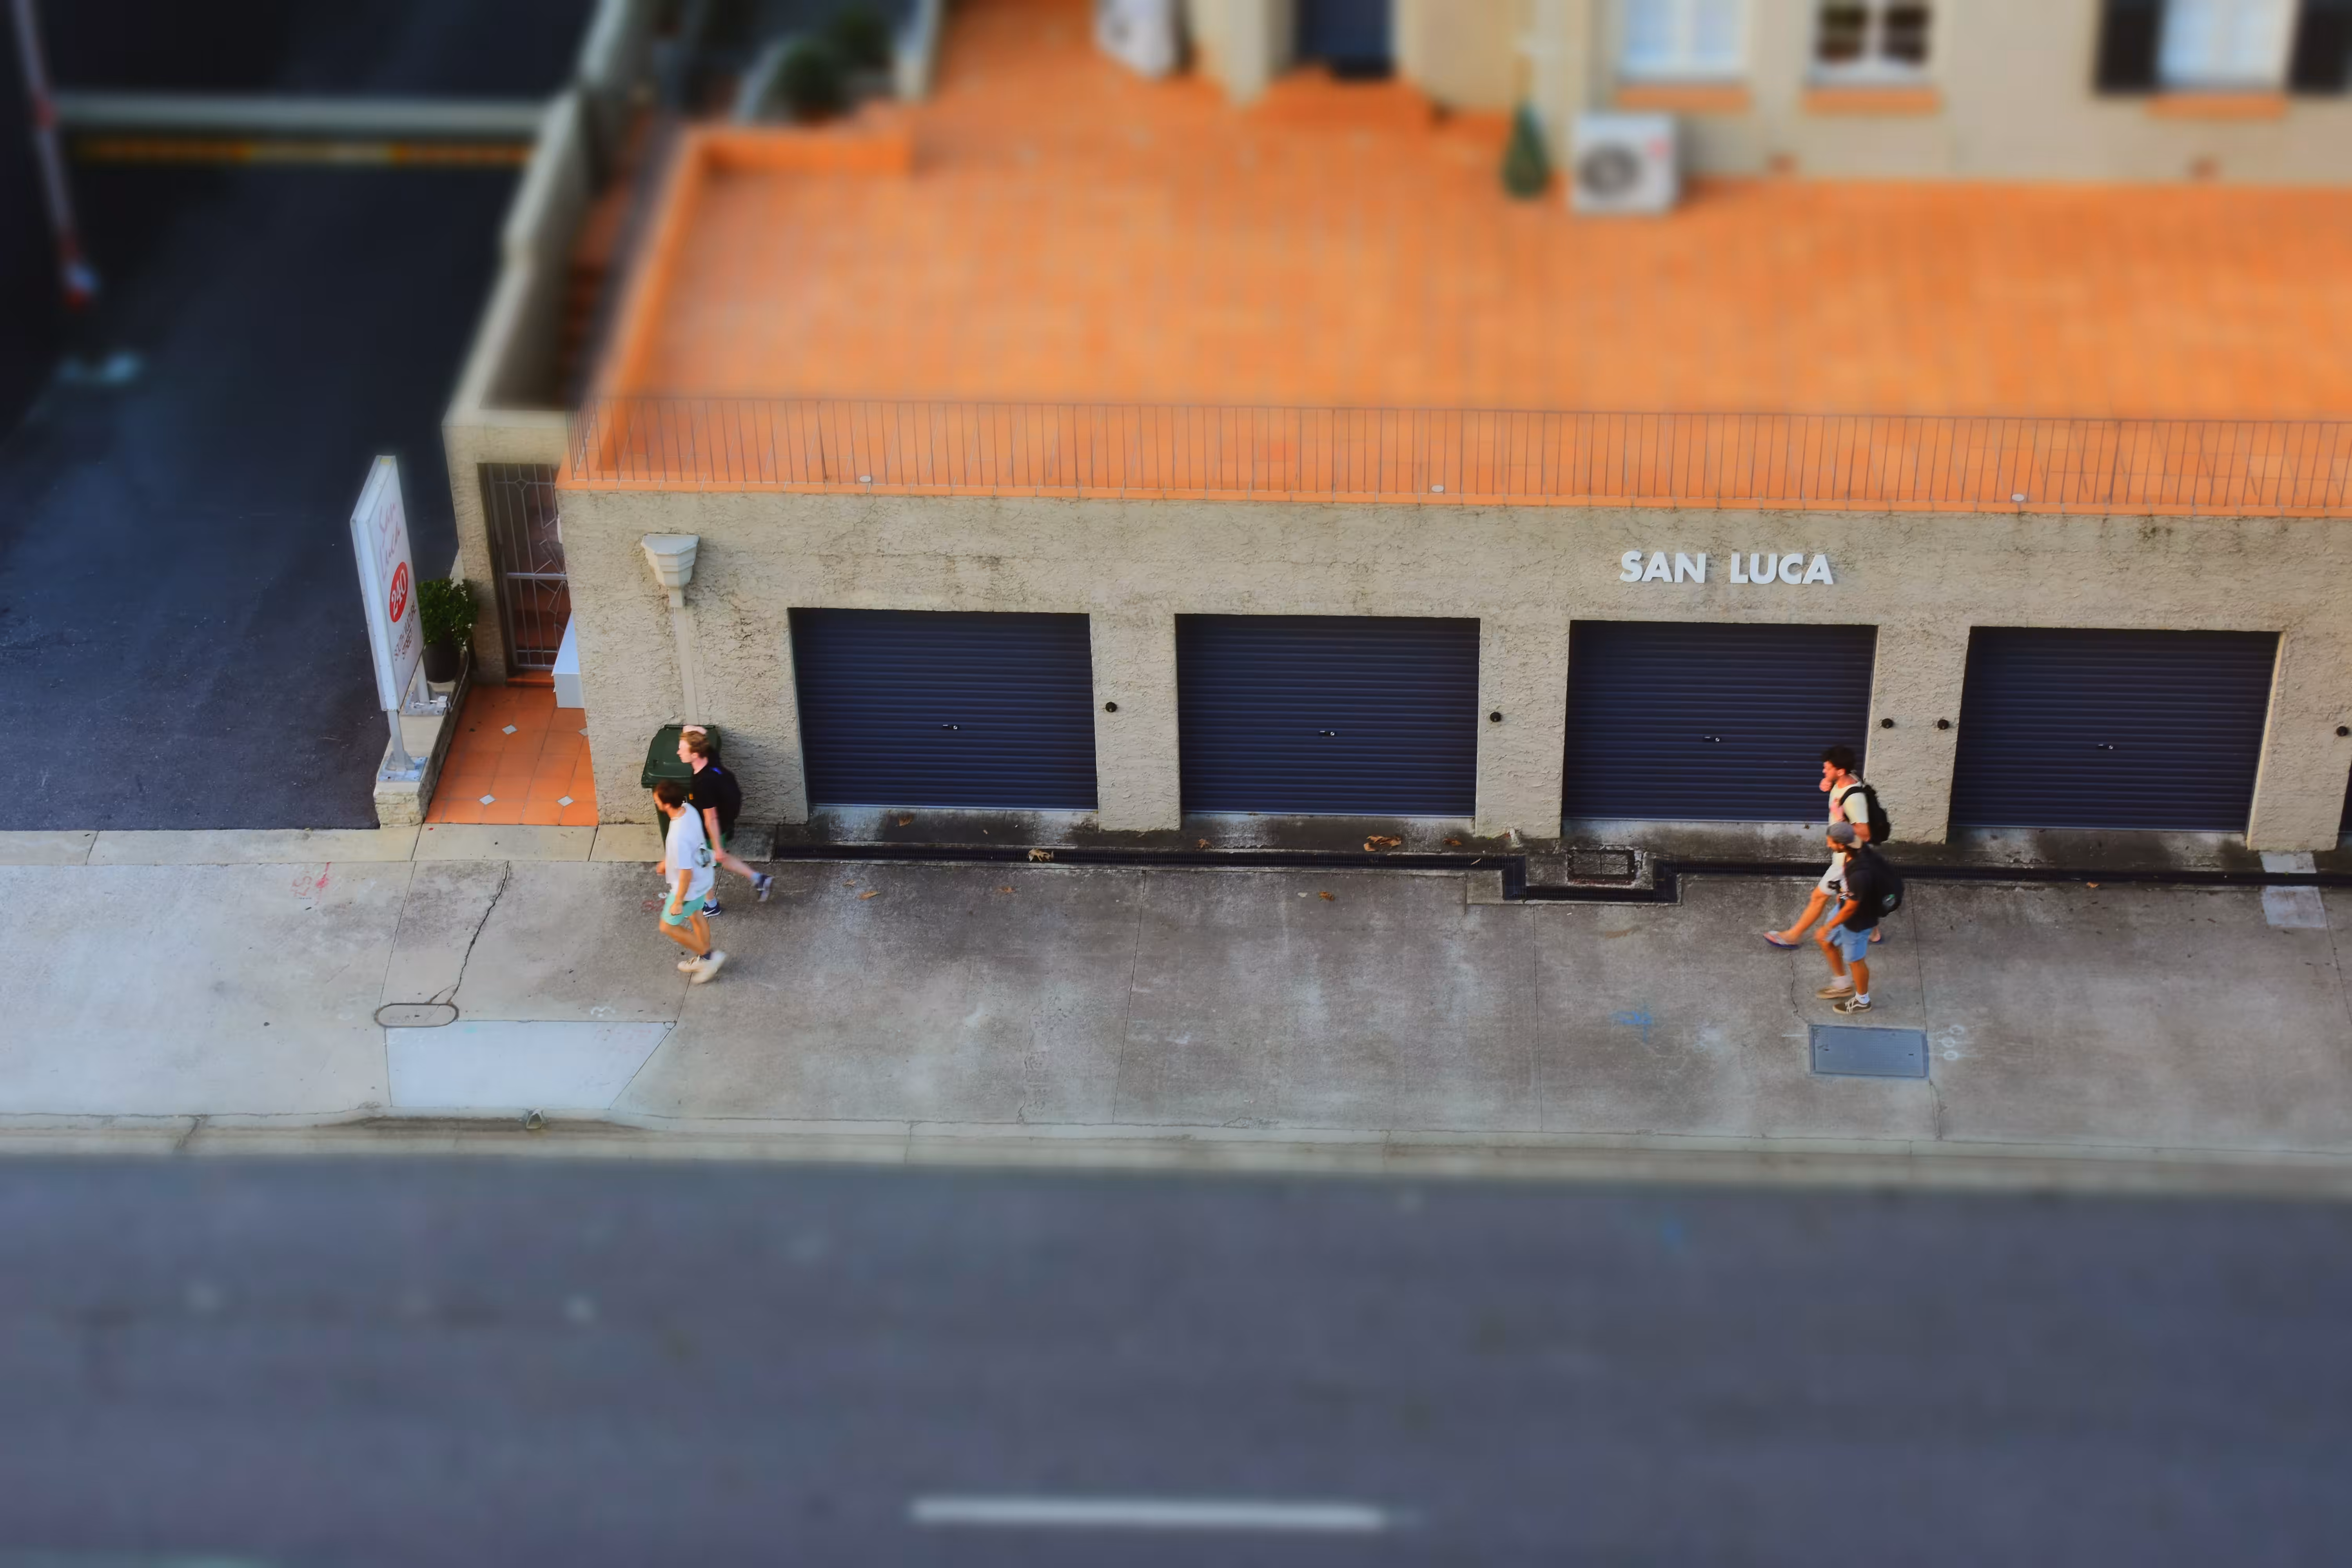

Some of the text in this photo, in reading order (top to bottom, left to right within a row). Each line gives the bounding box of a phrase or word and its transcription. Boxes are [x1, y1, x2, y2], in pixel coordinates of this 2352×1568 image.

[1619, 550, 1834, 585] SAN LUCA
[392, 569, 407, 618] 240
